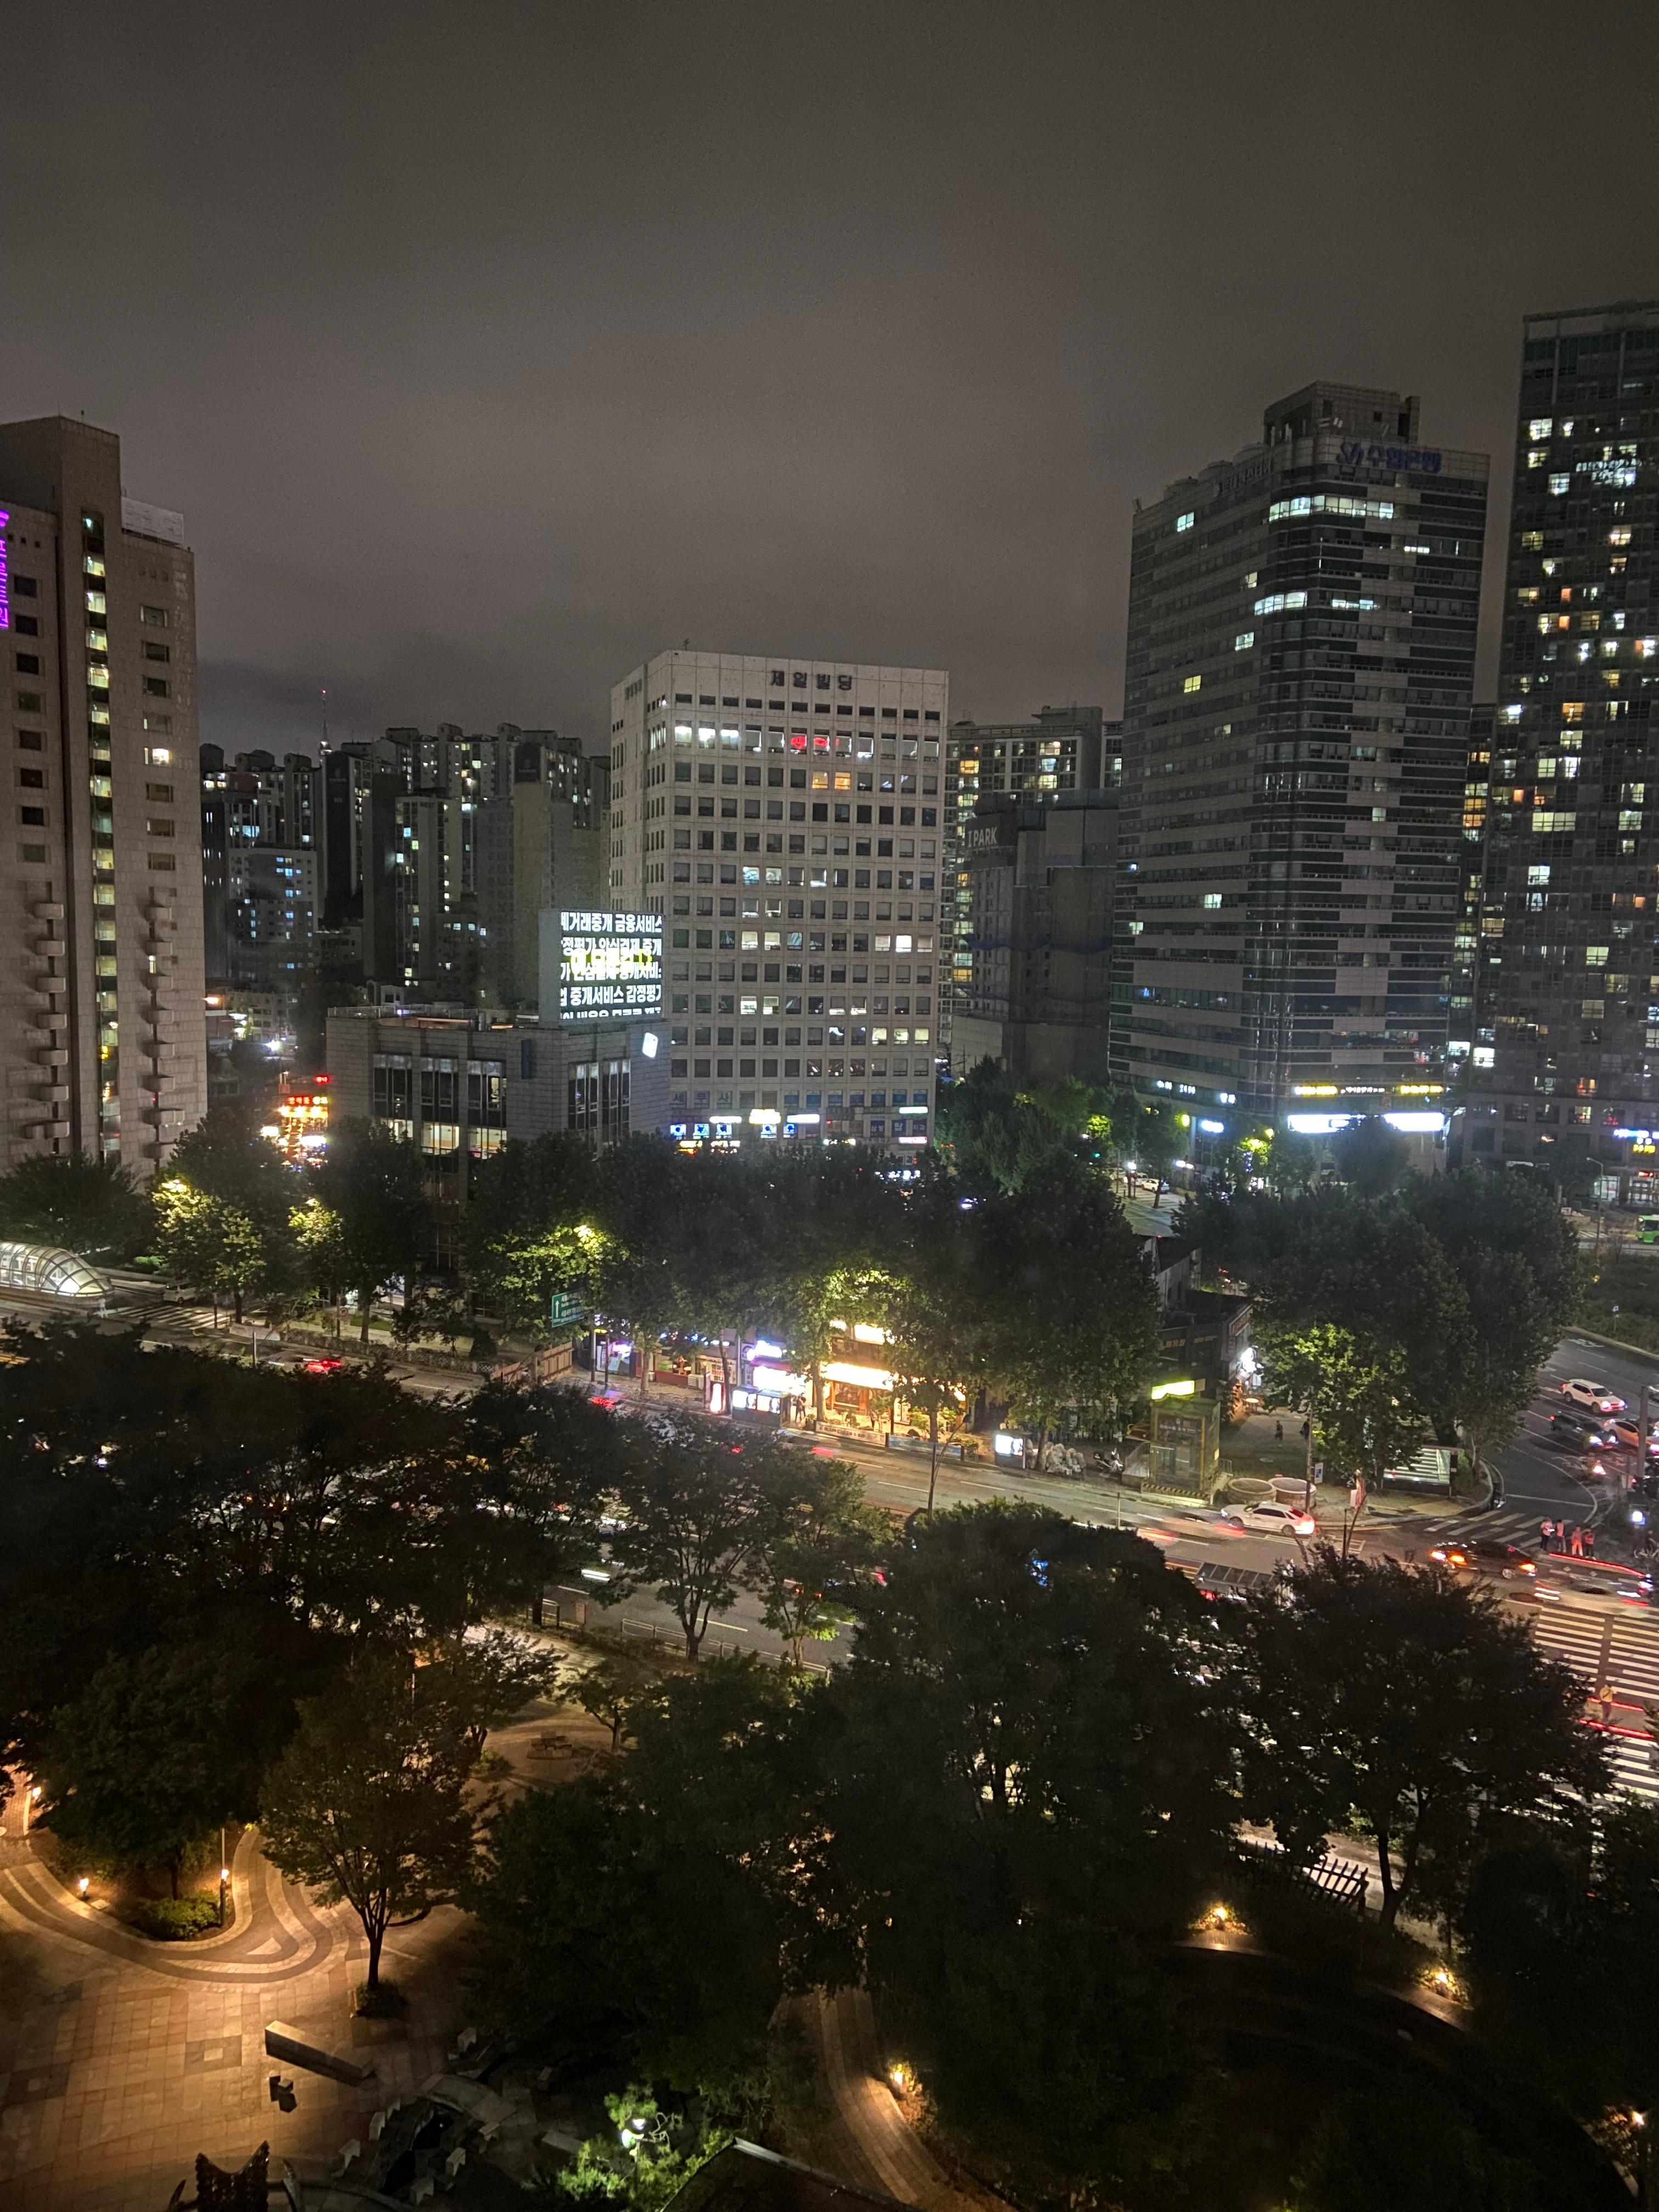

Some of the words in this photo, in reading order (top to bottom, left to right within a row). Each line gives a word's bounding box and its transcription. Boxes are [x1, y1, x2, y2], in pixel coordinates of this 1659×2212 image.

[771, 670, 853, 691] 제일빌딩
[616, 914, 662, 933] 금융서비스
[561, 937, 596, 956] 정평가
[571, 986, 624, 1006] 중개서비스
